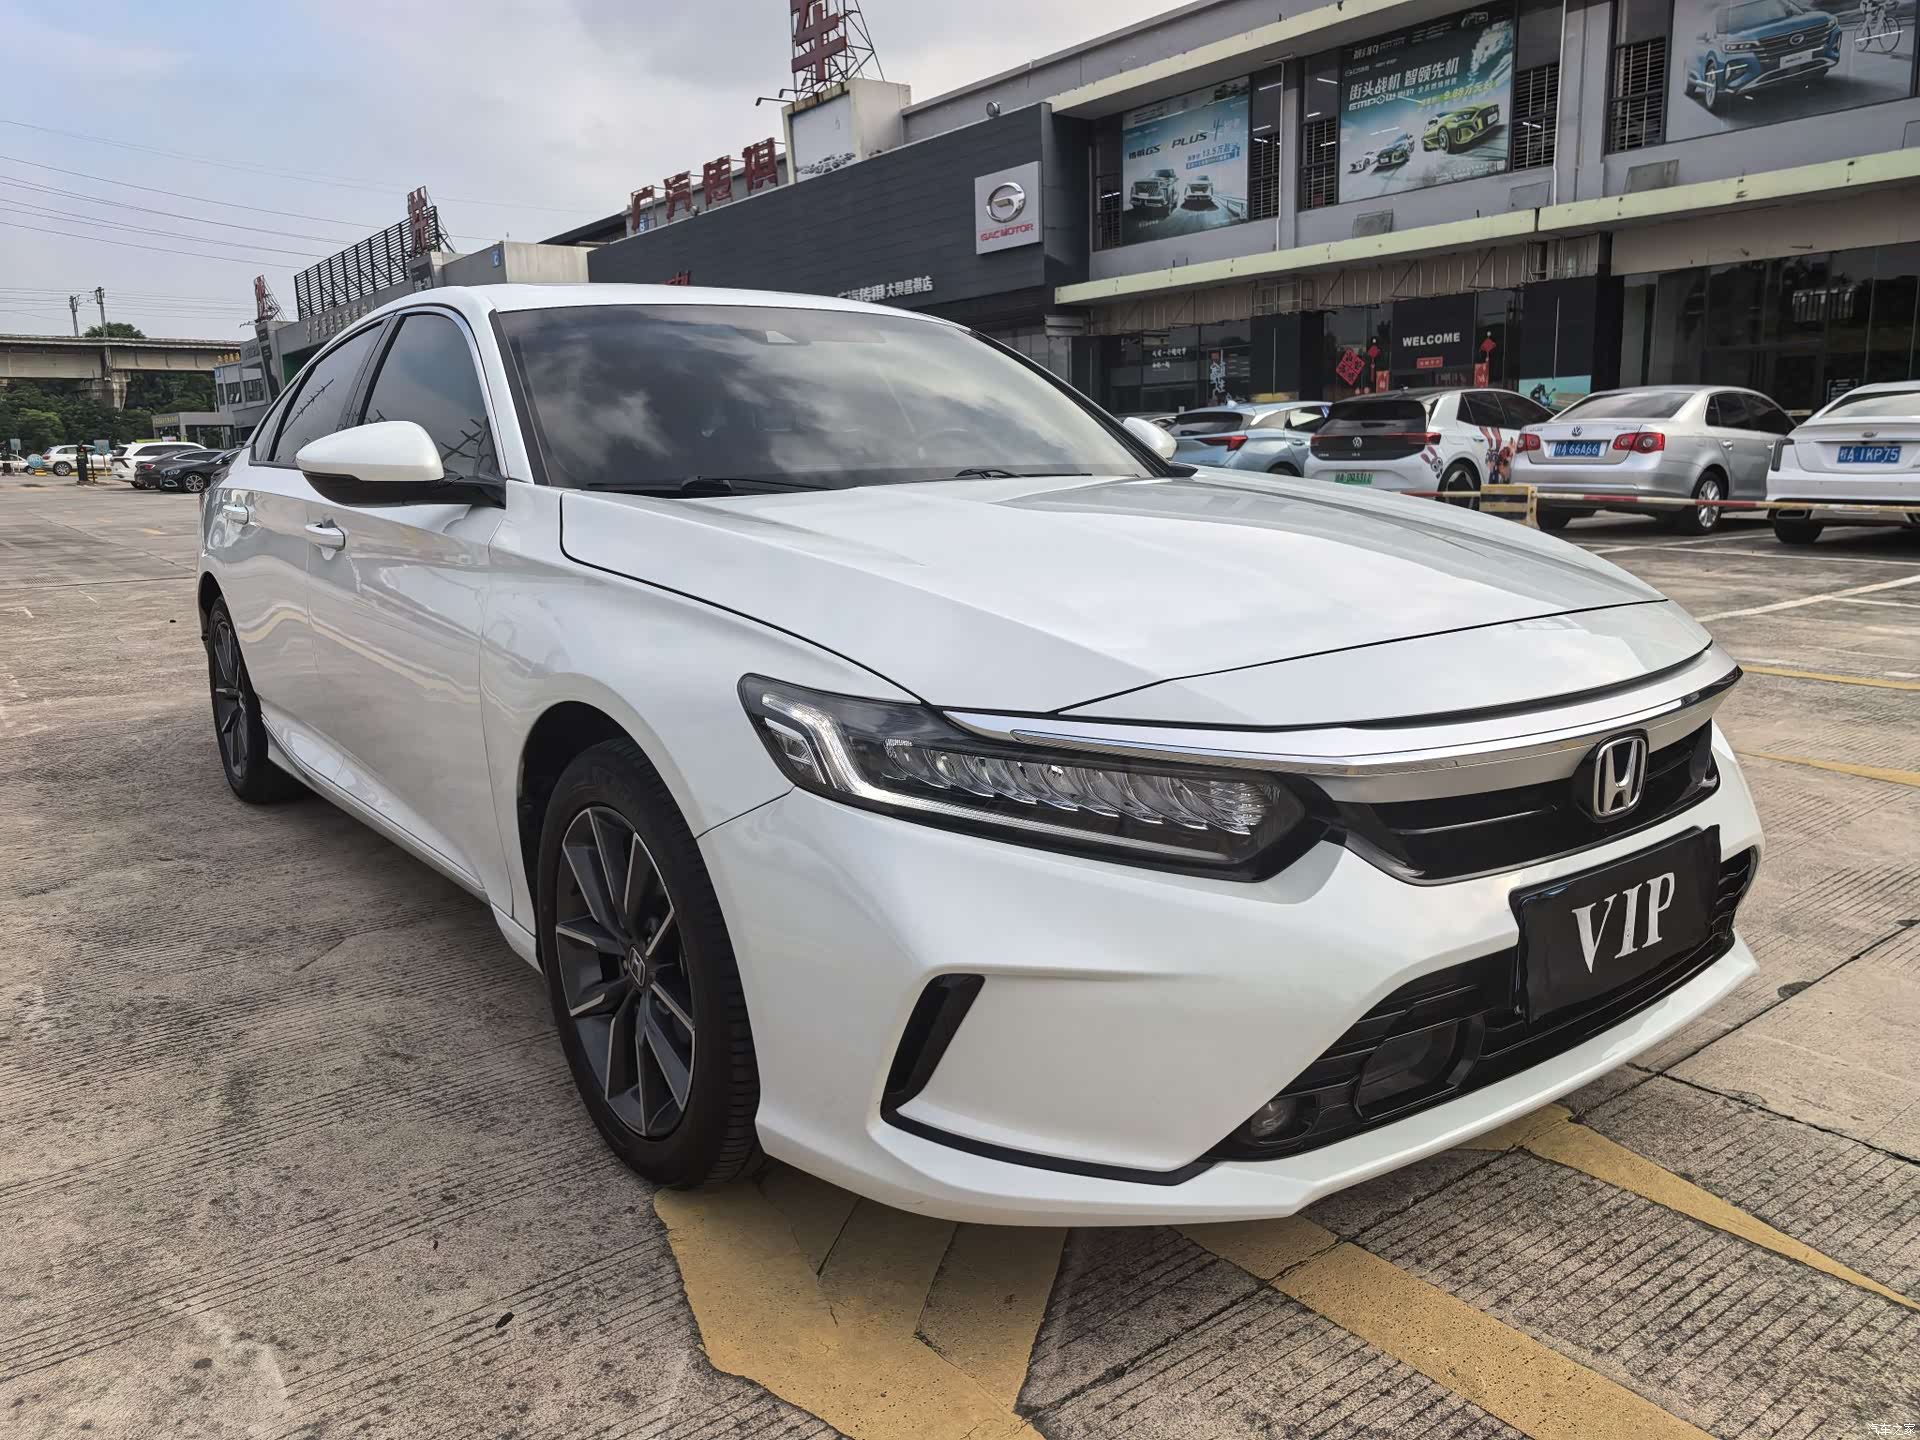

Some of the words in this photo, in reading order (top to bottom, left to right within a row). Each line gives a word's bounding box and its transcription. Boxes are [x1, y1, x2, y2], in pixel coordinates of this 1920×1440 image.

[1350, 73, 1401, 101] 街头战机
[1172, 132, 1208, 149] PLUS
[1402, 332, 1461, 347] WELCOME
[1572, 872, 1676, 973] VIP
